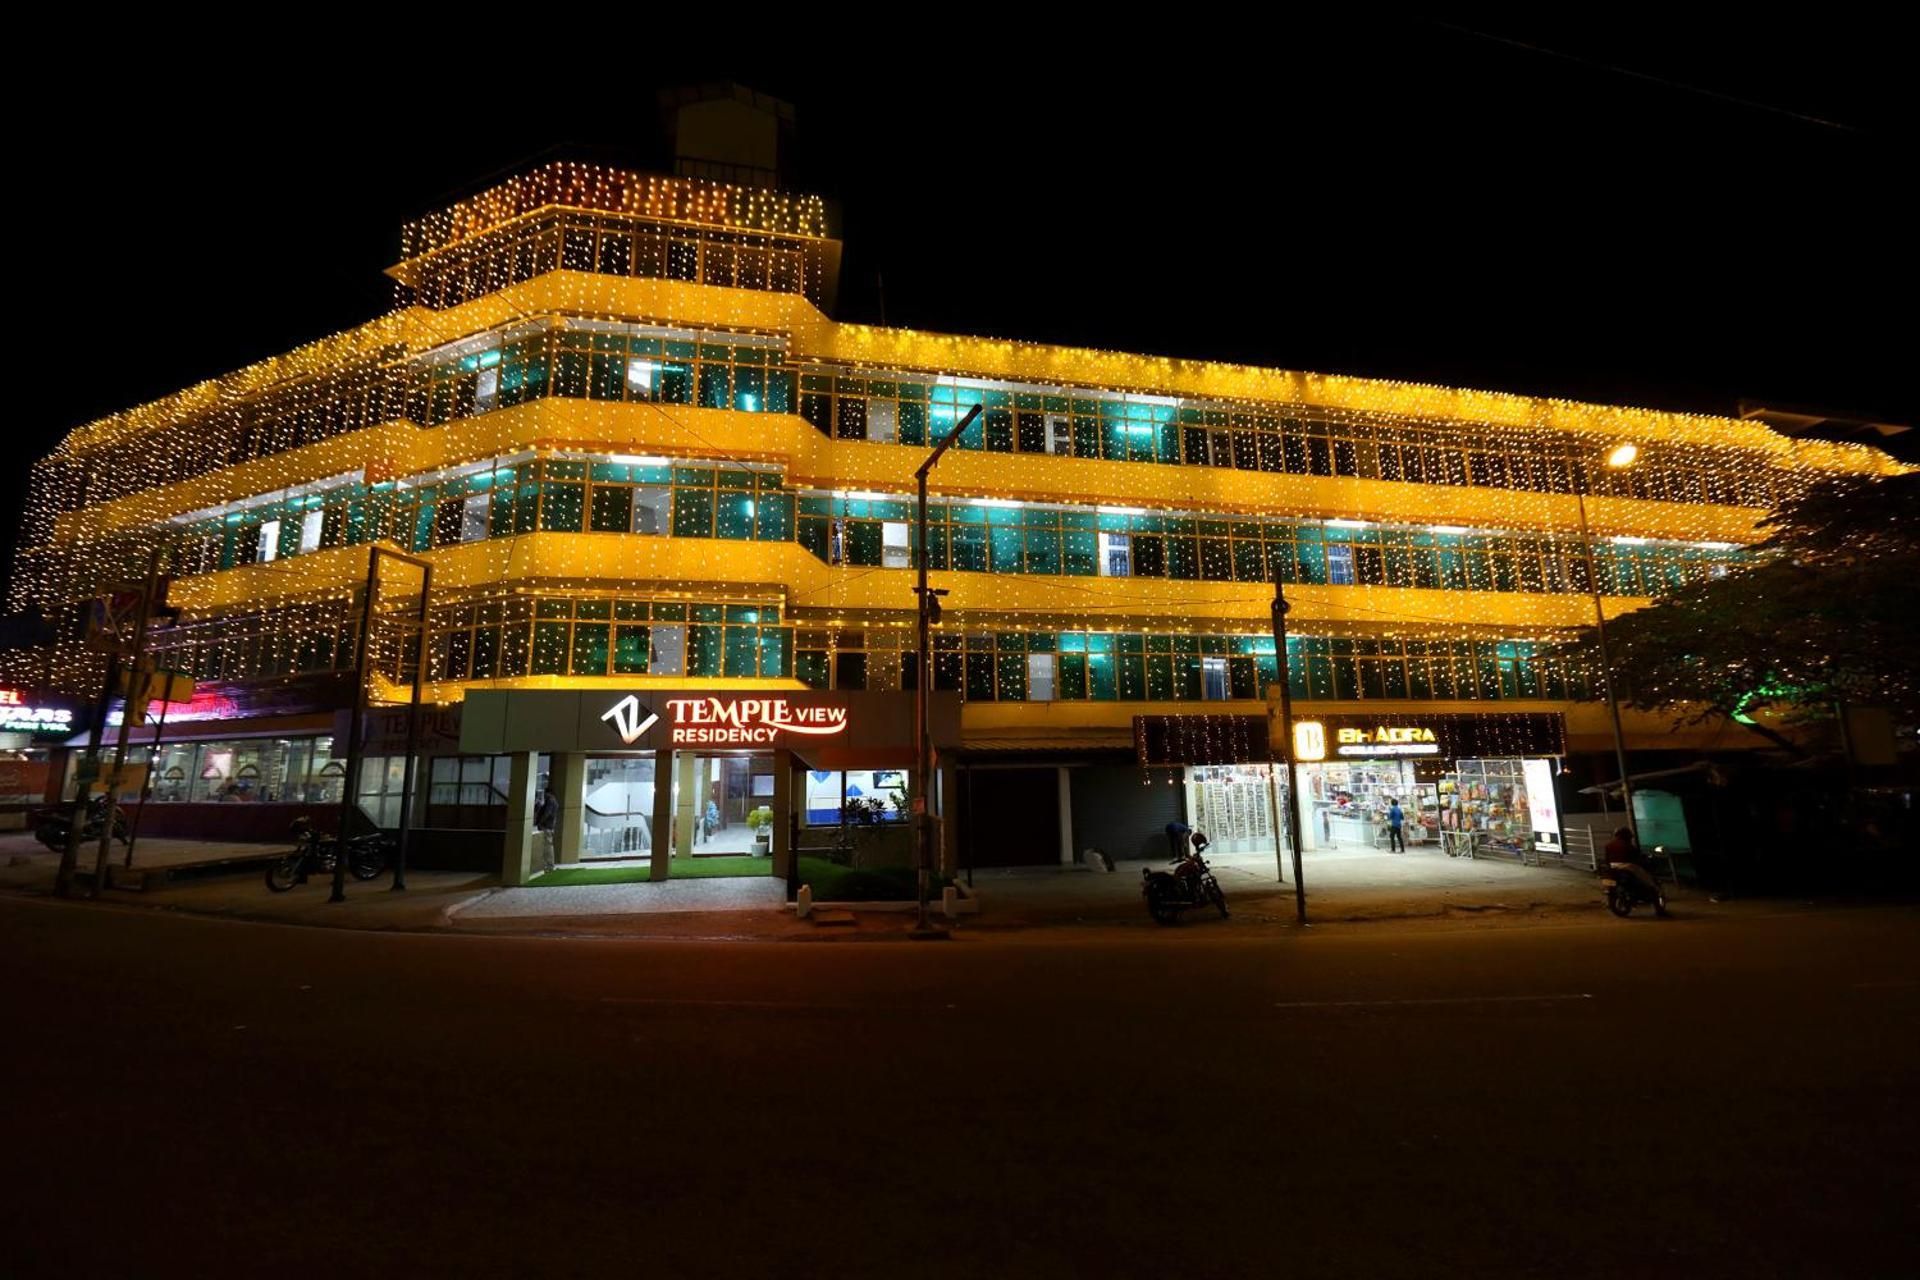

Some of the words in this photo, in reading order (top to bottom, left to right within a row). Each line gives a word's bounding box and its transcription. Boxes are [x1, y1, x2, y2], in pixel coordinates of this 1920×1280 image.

[666, 698, 793, 730] TEMPLE
[796, 708, 846, 722] VIEW
[673, 728, 778, 743] RESIDENCY
[1338, 726, 1436, 743] BHADRA
